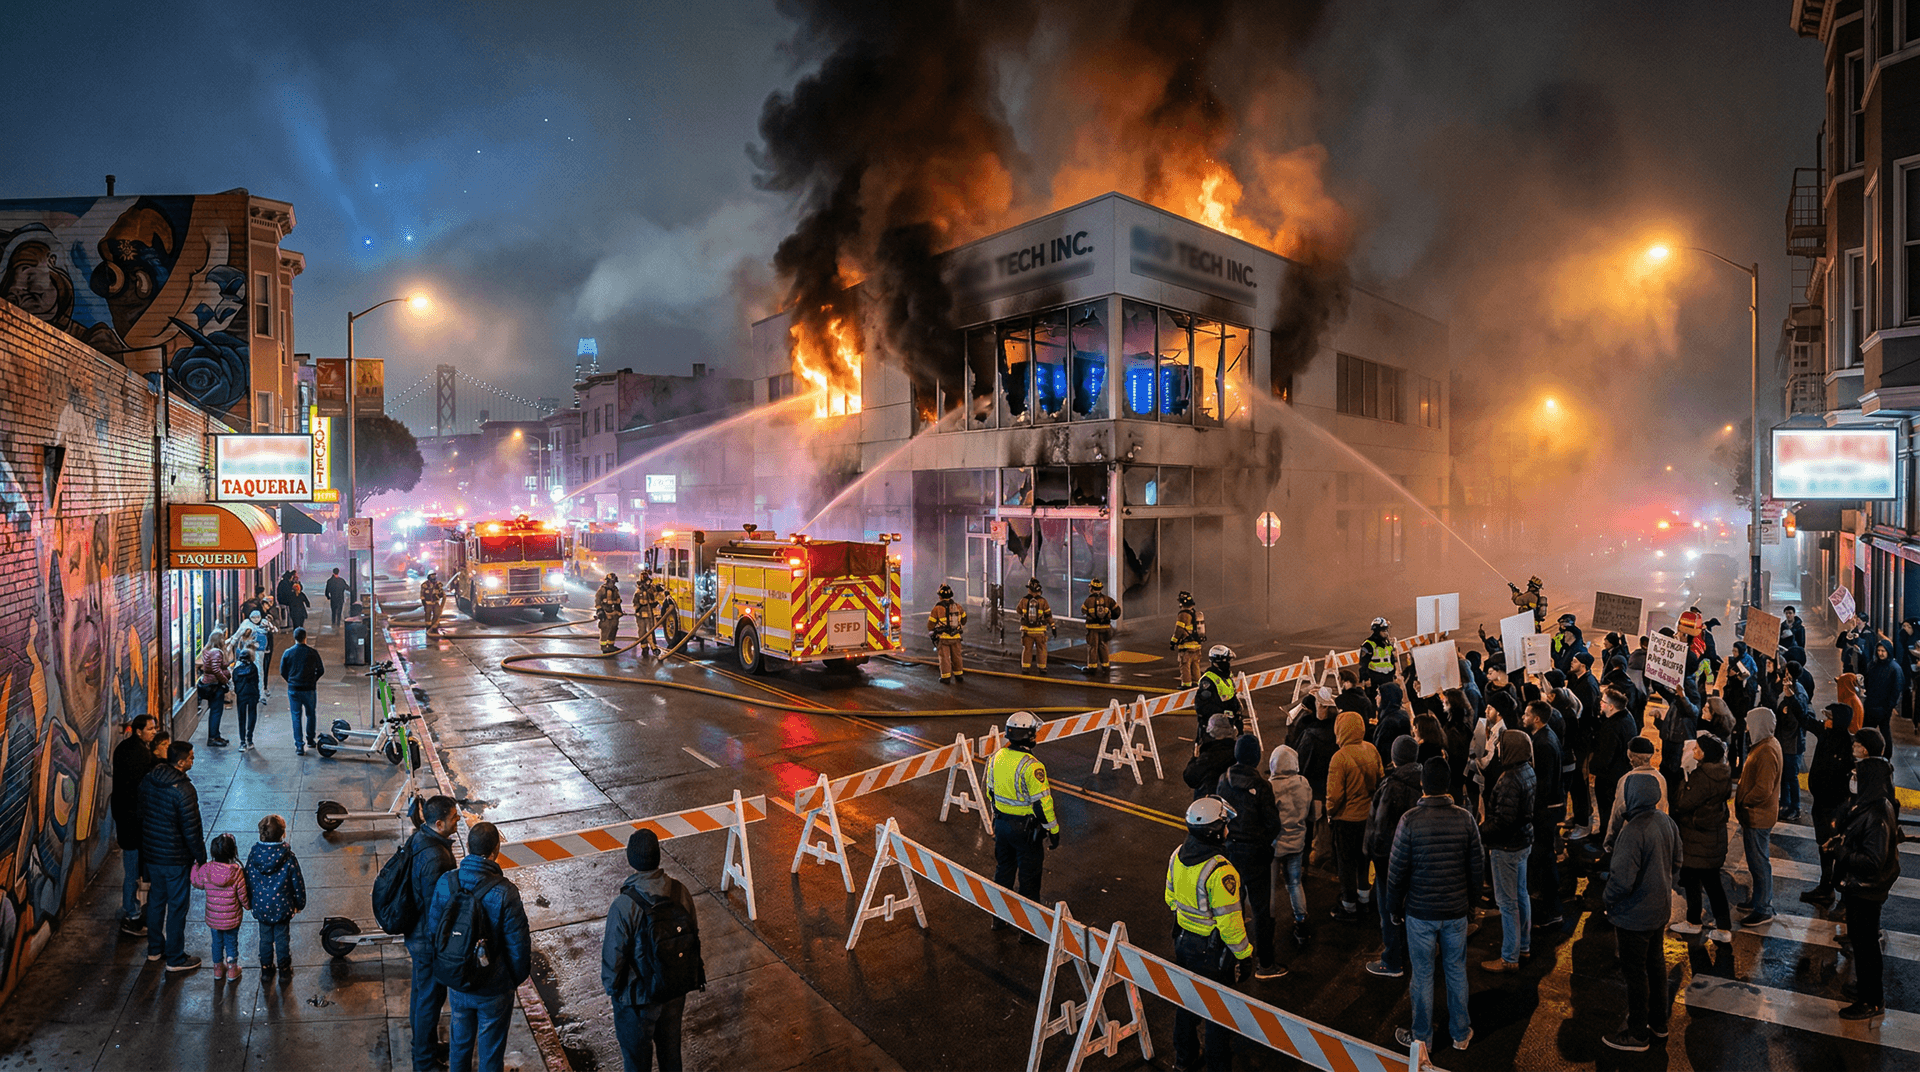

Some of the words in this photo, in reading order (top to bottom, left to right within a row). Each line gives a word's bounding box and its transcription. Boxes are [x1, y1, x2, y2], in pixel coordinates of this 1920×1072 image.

[1051, 231, 1093, 263] INC.
[1227, 259, 1257, 288] INC.
[222, 479, 308, 497] TAQUERIA
[178, 554, 248, 567] TAQUERIA
[834, 622, 861, 633] SFFD
